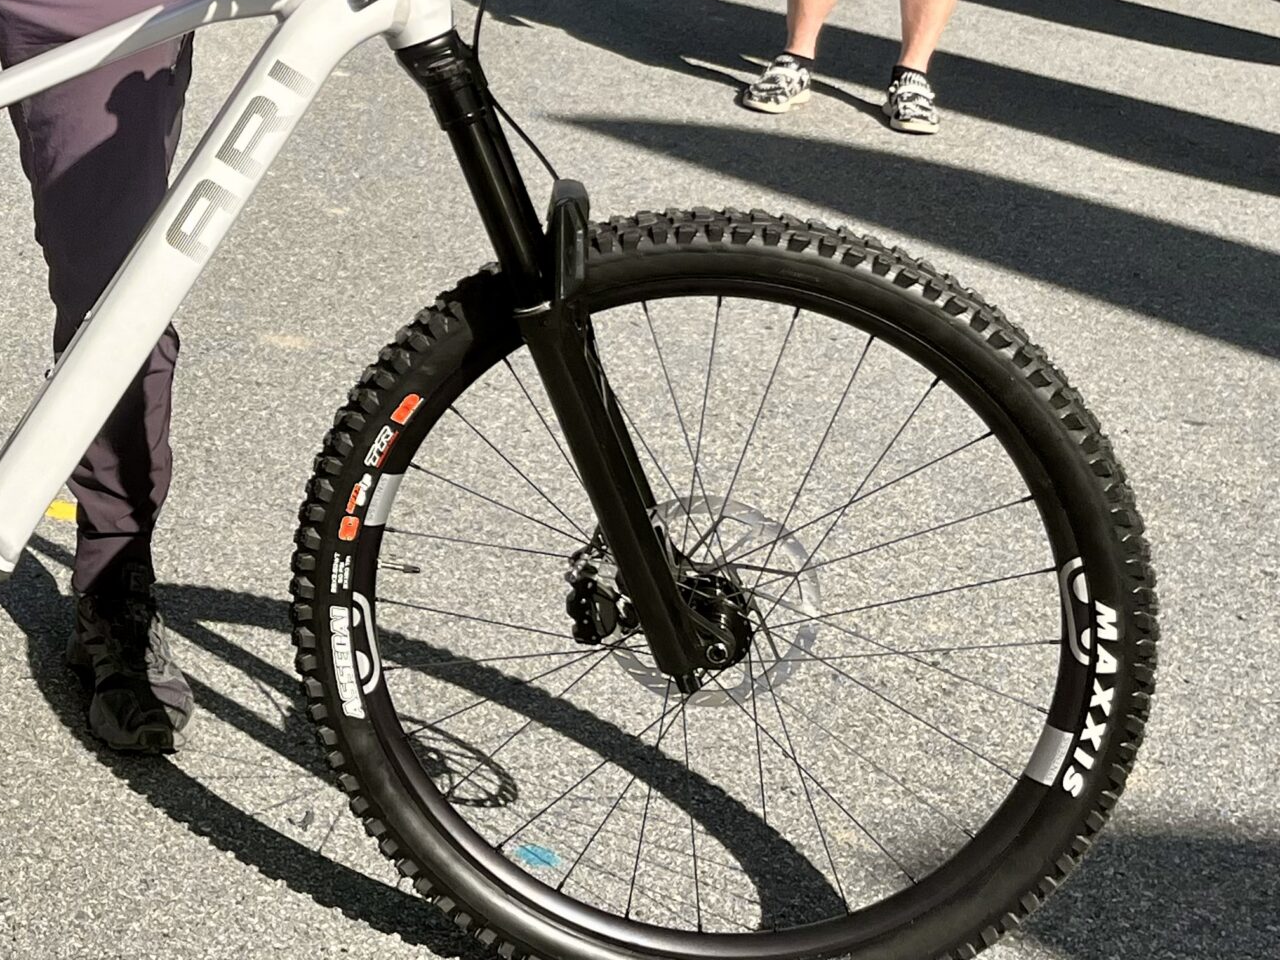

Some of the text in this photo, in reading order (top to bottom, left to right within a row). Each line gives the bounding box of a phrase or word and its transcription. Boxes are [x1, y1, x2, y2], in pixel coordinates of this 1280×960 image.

[166, 59, 317, 264] ARI
[330, 605, 366, 720] ASSEGAI
[1063, 600, 1118, 798] MAXXIS
